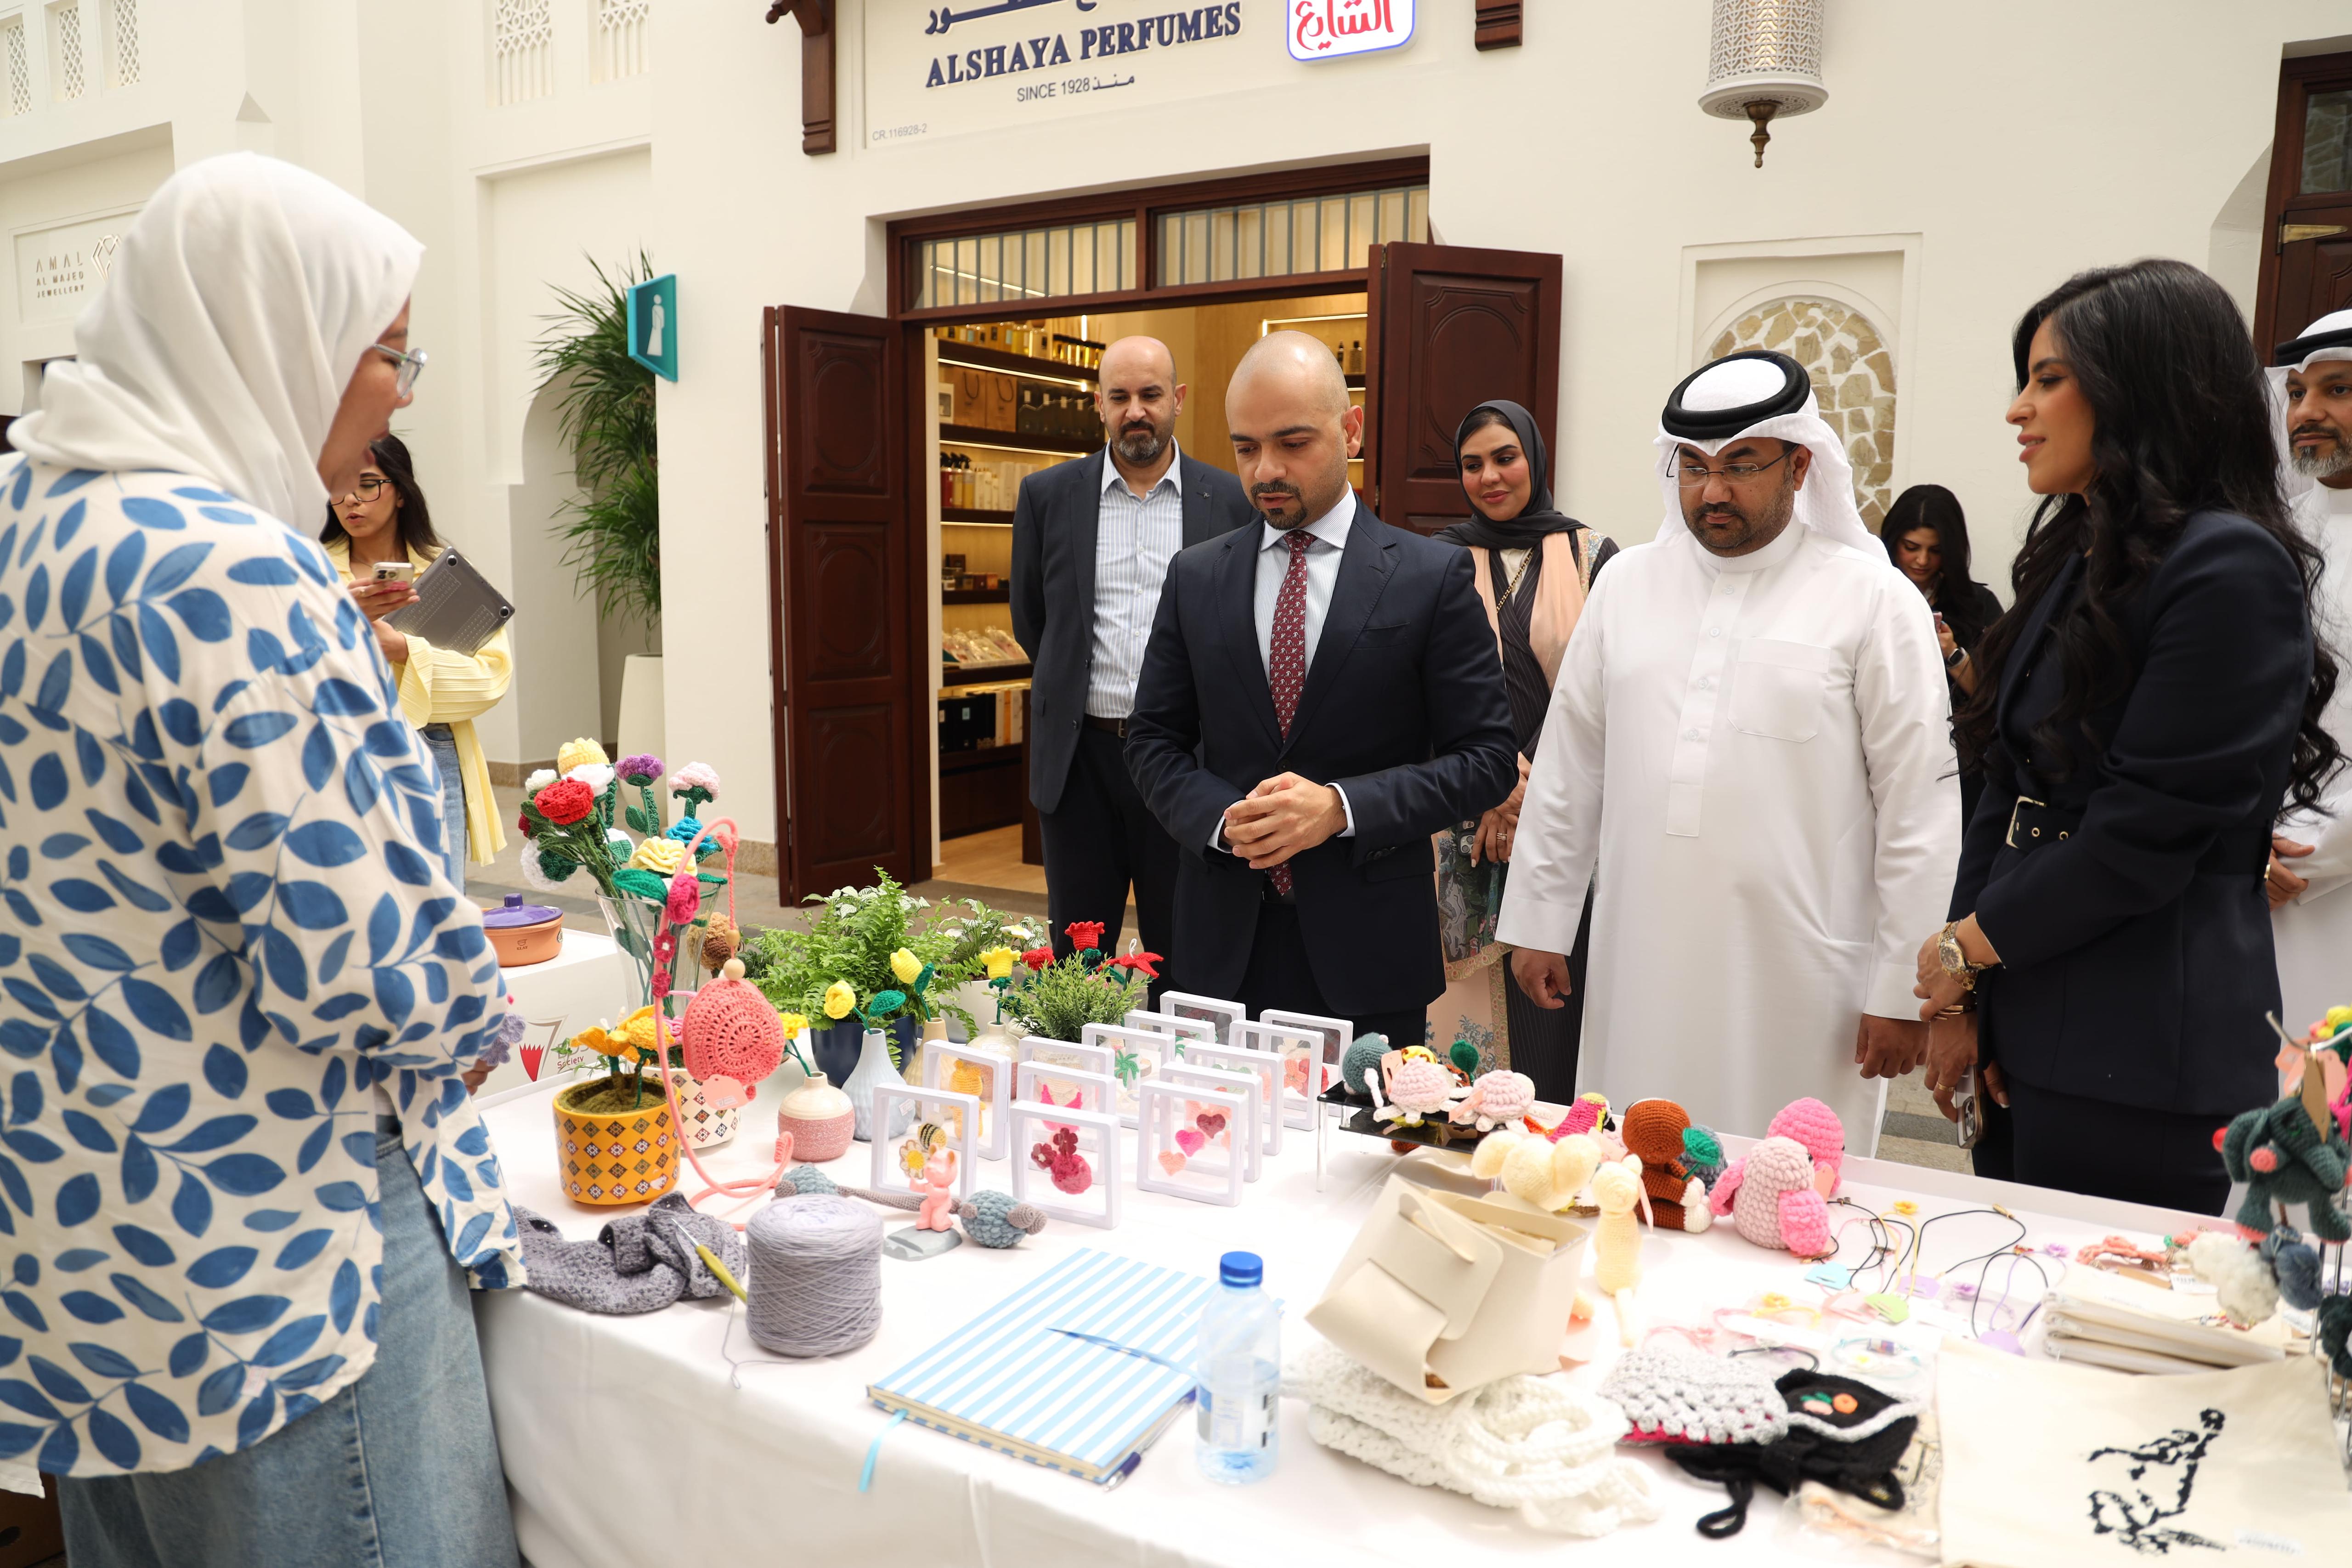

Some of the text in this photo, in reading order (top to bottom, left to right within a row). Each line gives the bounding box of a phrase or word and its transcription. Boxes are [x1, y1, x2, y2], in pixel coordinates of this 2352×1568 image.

[926, 34, 1071, 88] ALSHAYA
[1080, 2, 1240, 60] PERFUMES
[1017, 77, 1090, 102] SINCE 1928
[1092, 74, 1135, 90] منذ
[36, 251, 83, 273] AMAL
[37, 271, 84, 286] AL MAJED
[37, 284, 84, 299] JEWELLERY
